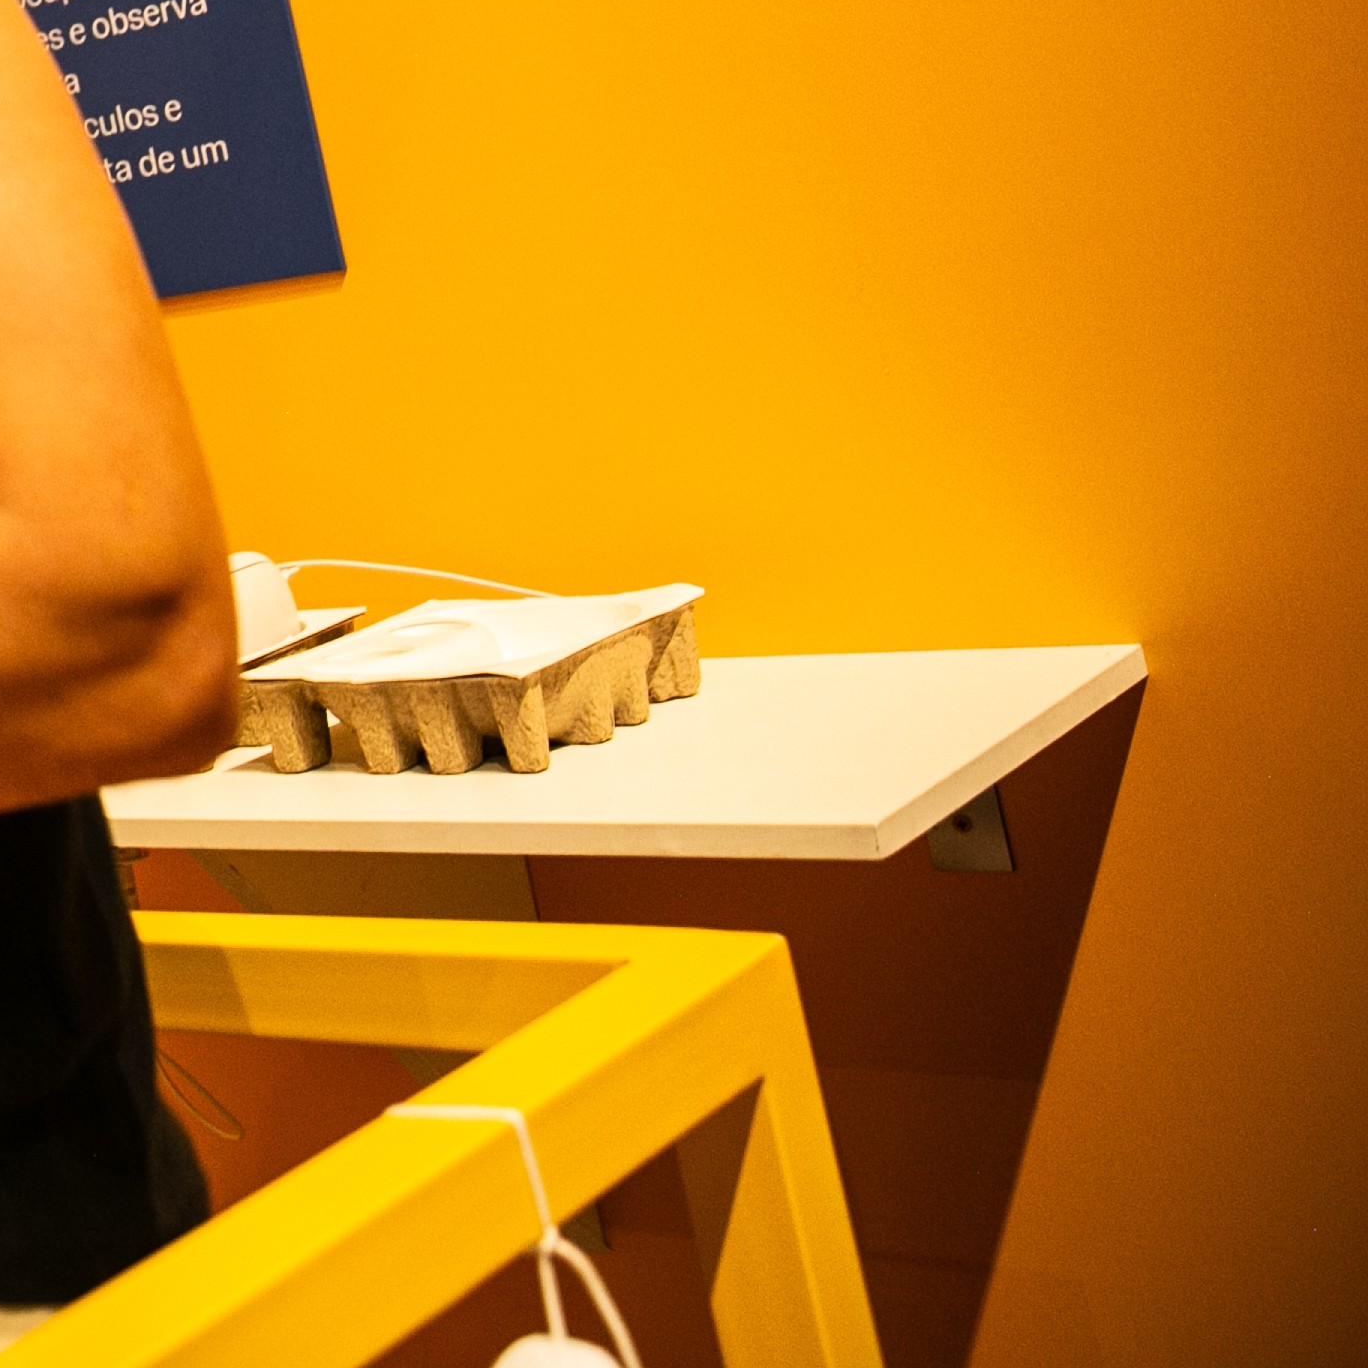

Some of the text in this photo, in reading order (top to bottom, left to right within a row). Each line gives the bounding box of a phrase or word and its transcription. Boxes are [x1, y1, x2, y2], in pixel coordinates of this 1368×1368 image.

[69, 23, 87, 45] e
[84, 99, 183, 139] culos e
[103, 139, 230, 183] ta de um
